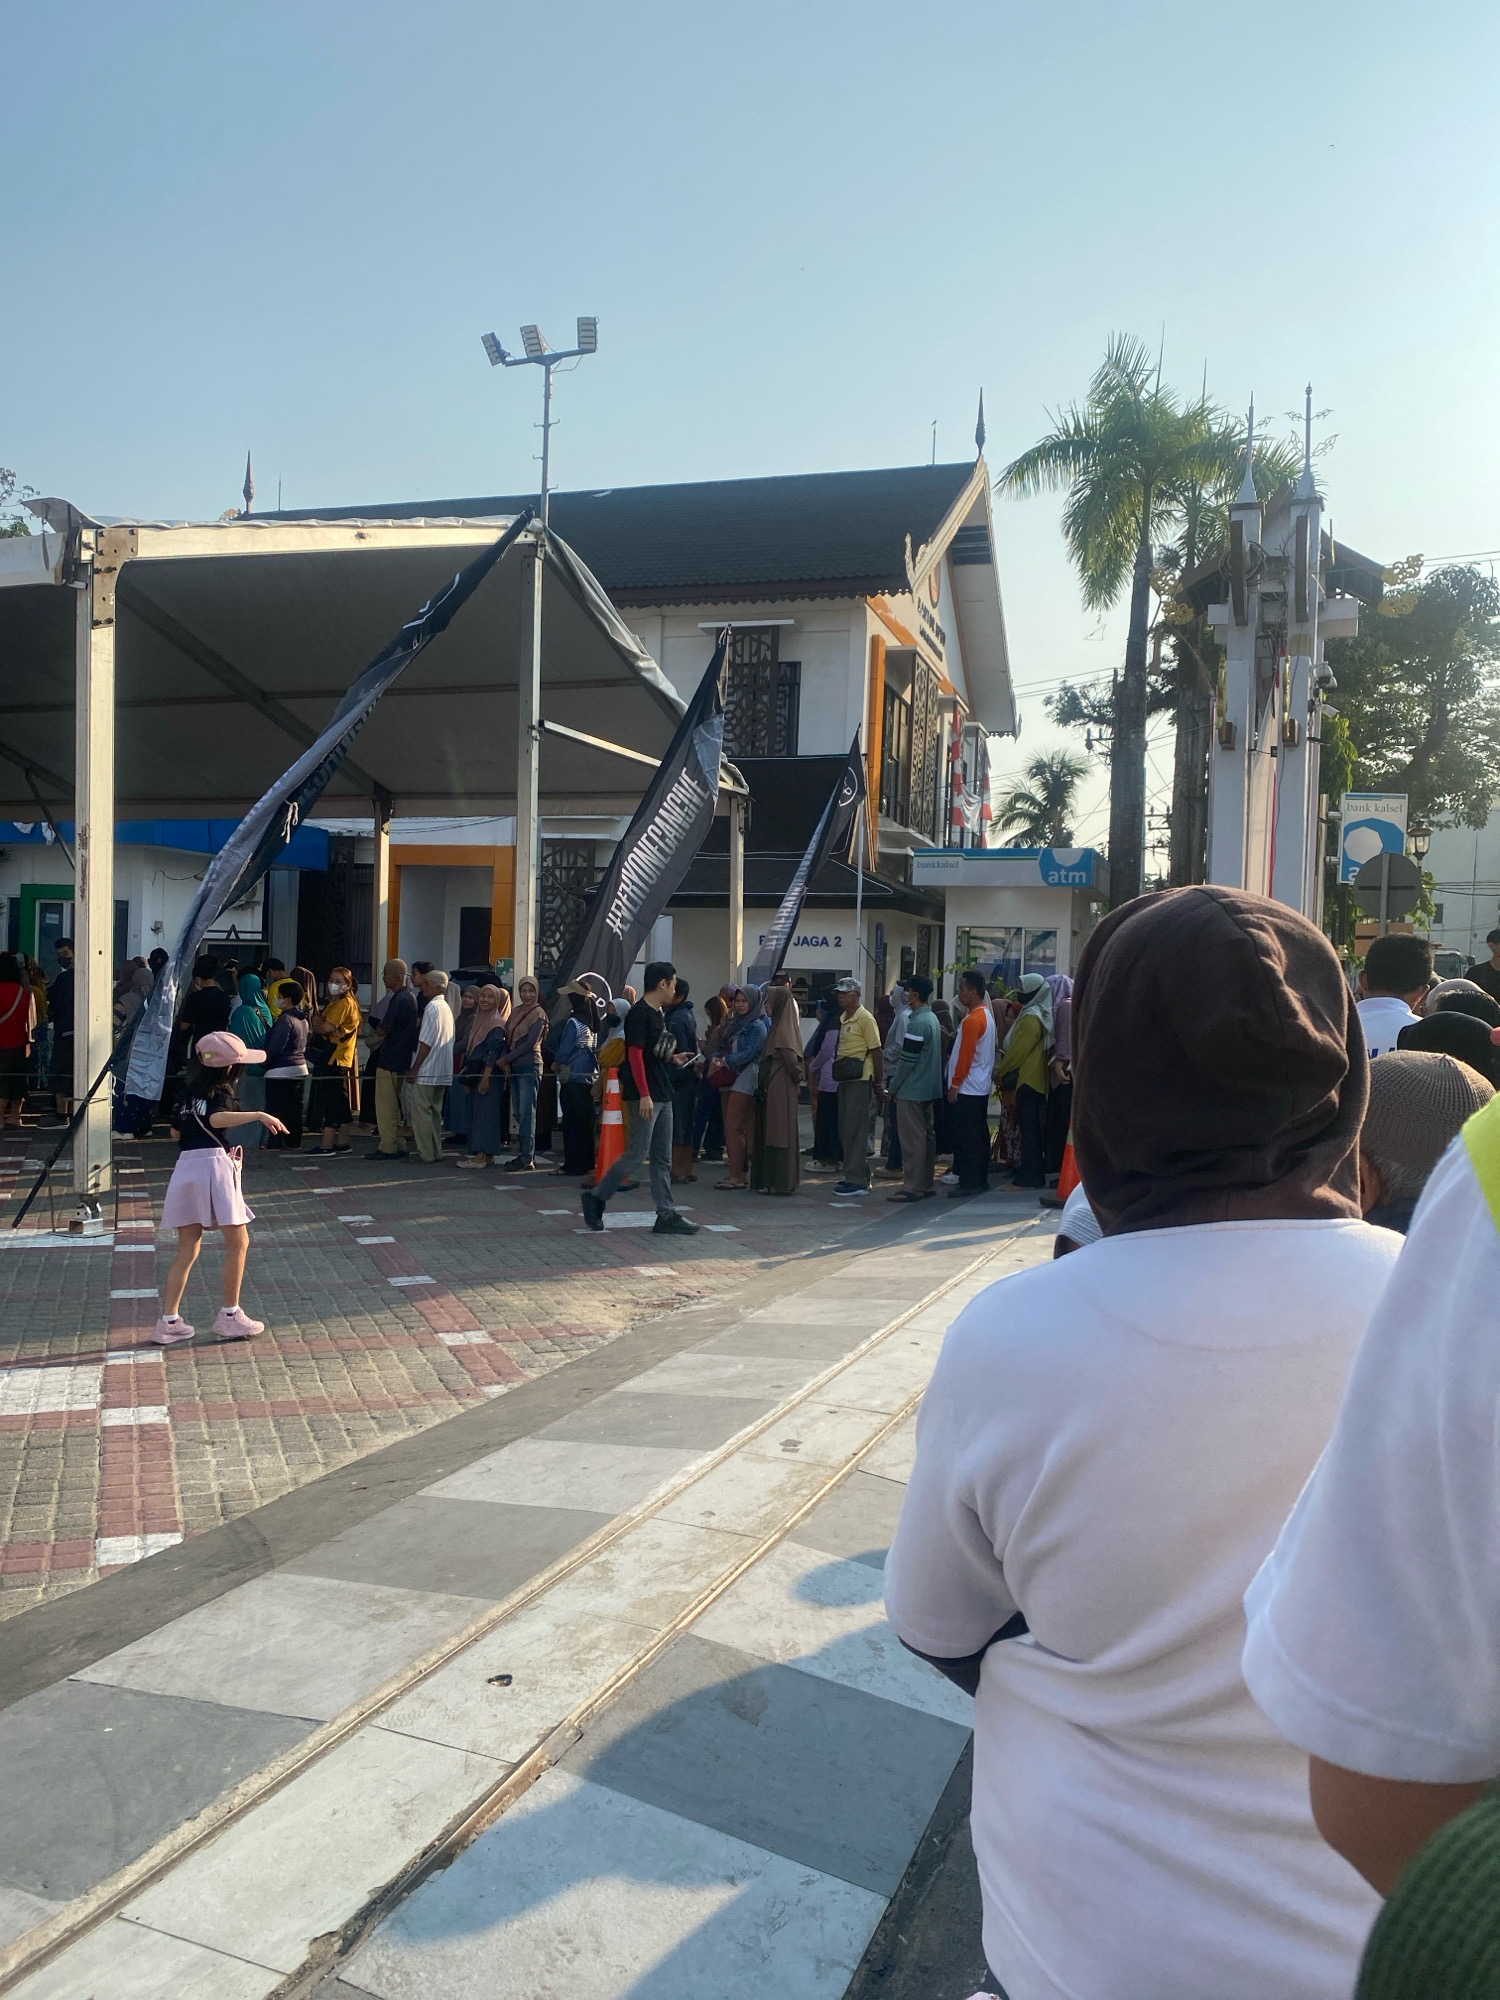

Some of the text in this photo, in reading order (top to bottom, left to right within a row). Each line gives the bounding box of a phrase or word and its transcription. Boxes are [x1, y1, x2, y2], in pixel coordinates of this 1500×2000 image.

[1347, 803, 1403, 813] bank kalsel
[605, 766, 710, 941] #EVERYONECANGIVE
[1048, 869, 1087, 884] atm
[793, 935, 842, 947] JAGA 2
